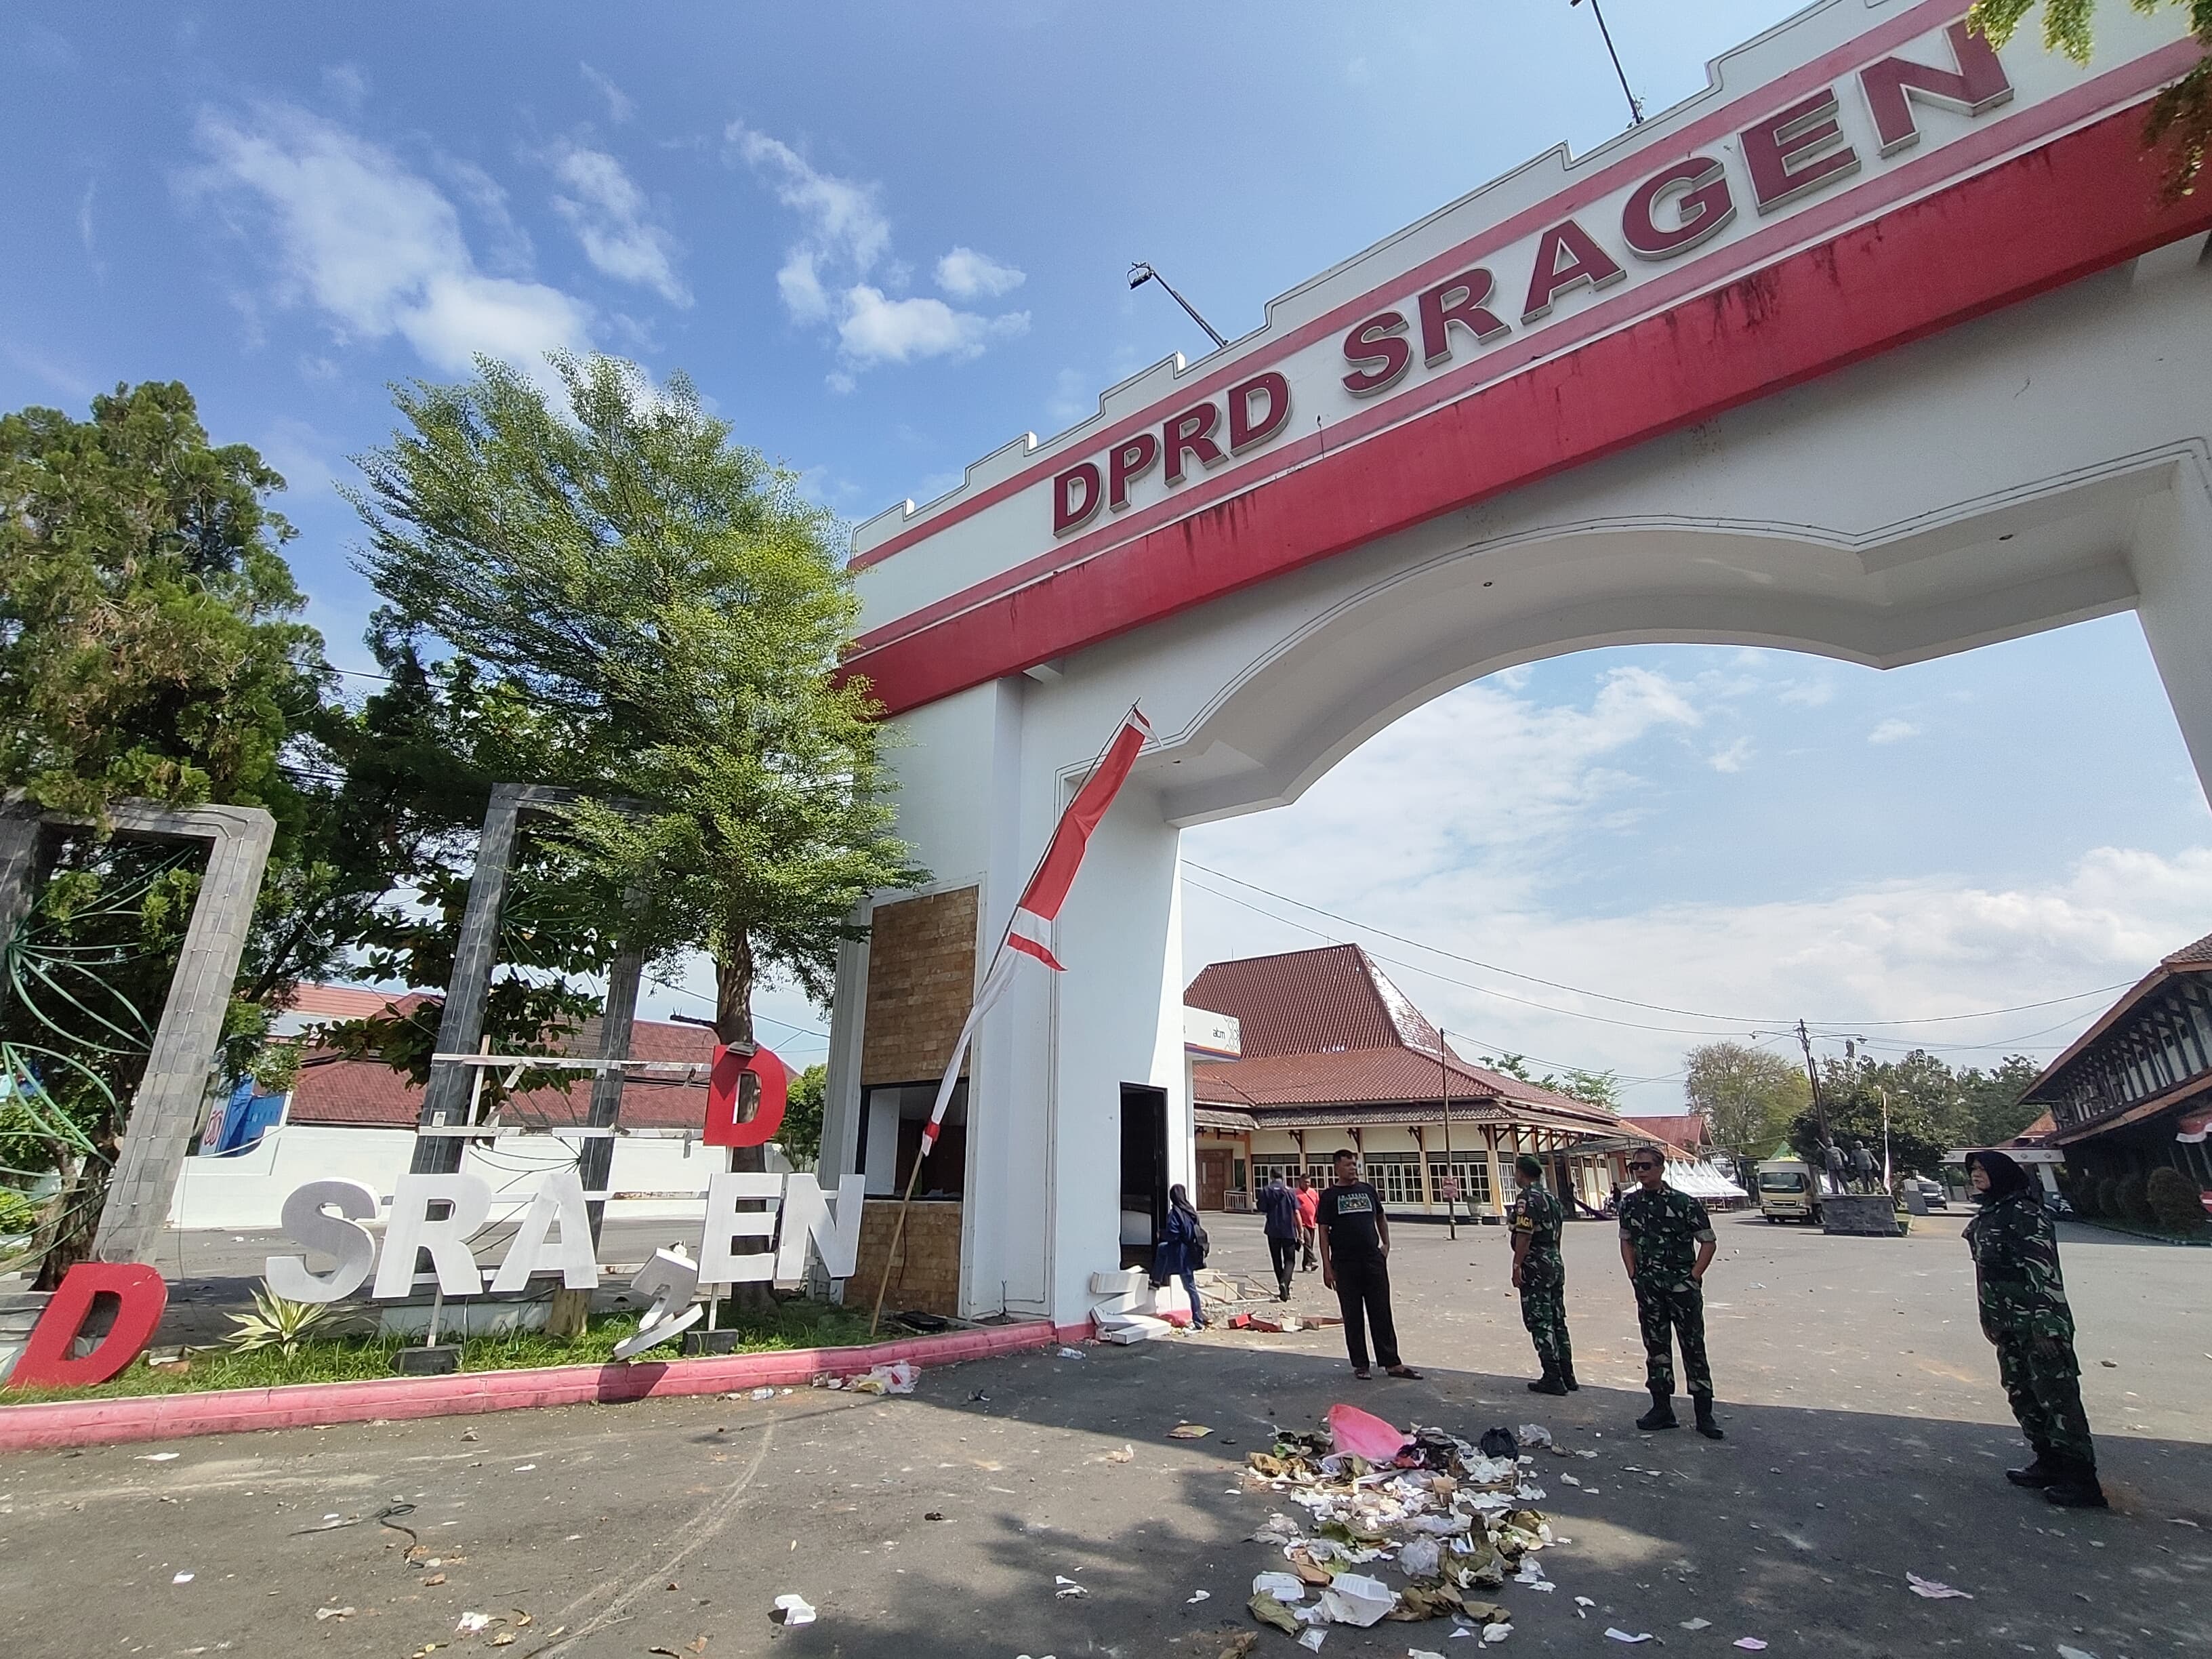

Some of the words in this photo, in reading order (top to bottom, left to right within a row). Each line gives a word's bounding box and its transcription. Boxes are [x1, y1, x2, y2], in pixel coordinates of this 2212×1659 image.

[1052, 371, 1292, 538] DPRD
[1340, 15, 2014, 398] SRAGEN
[703, 1044, 788, 1148] D
